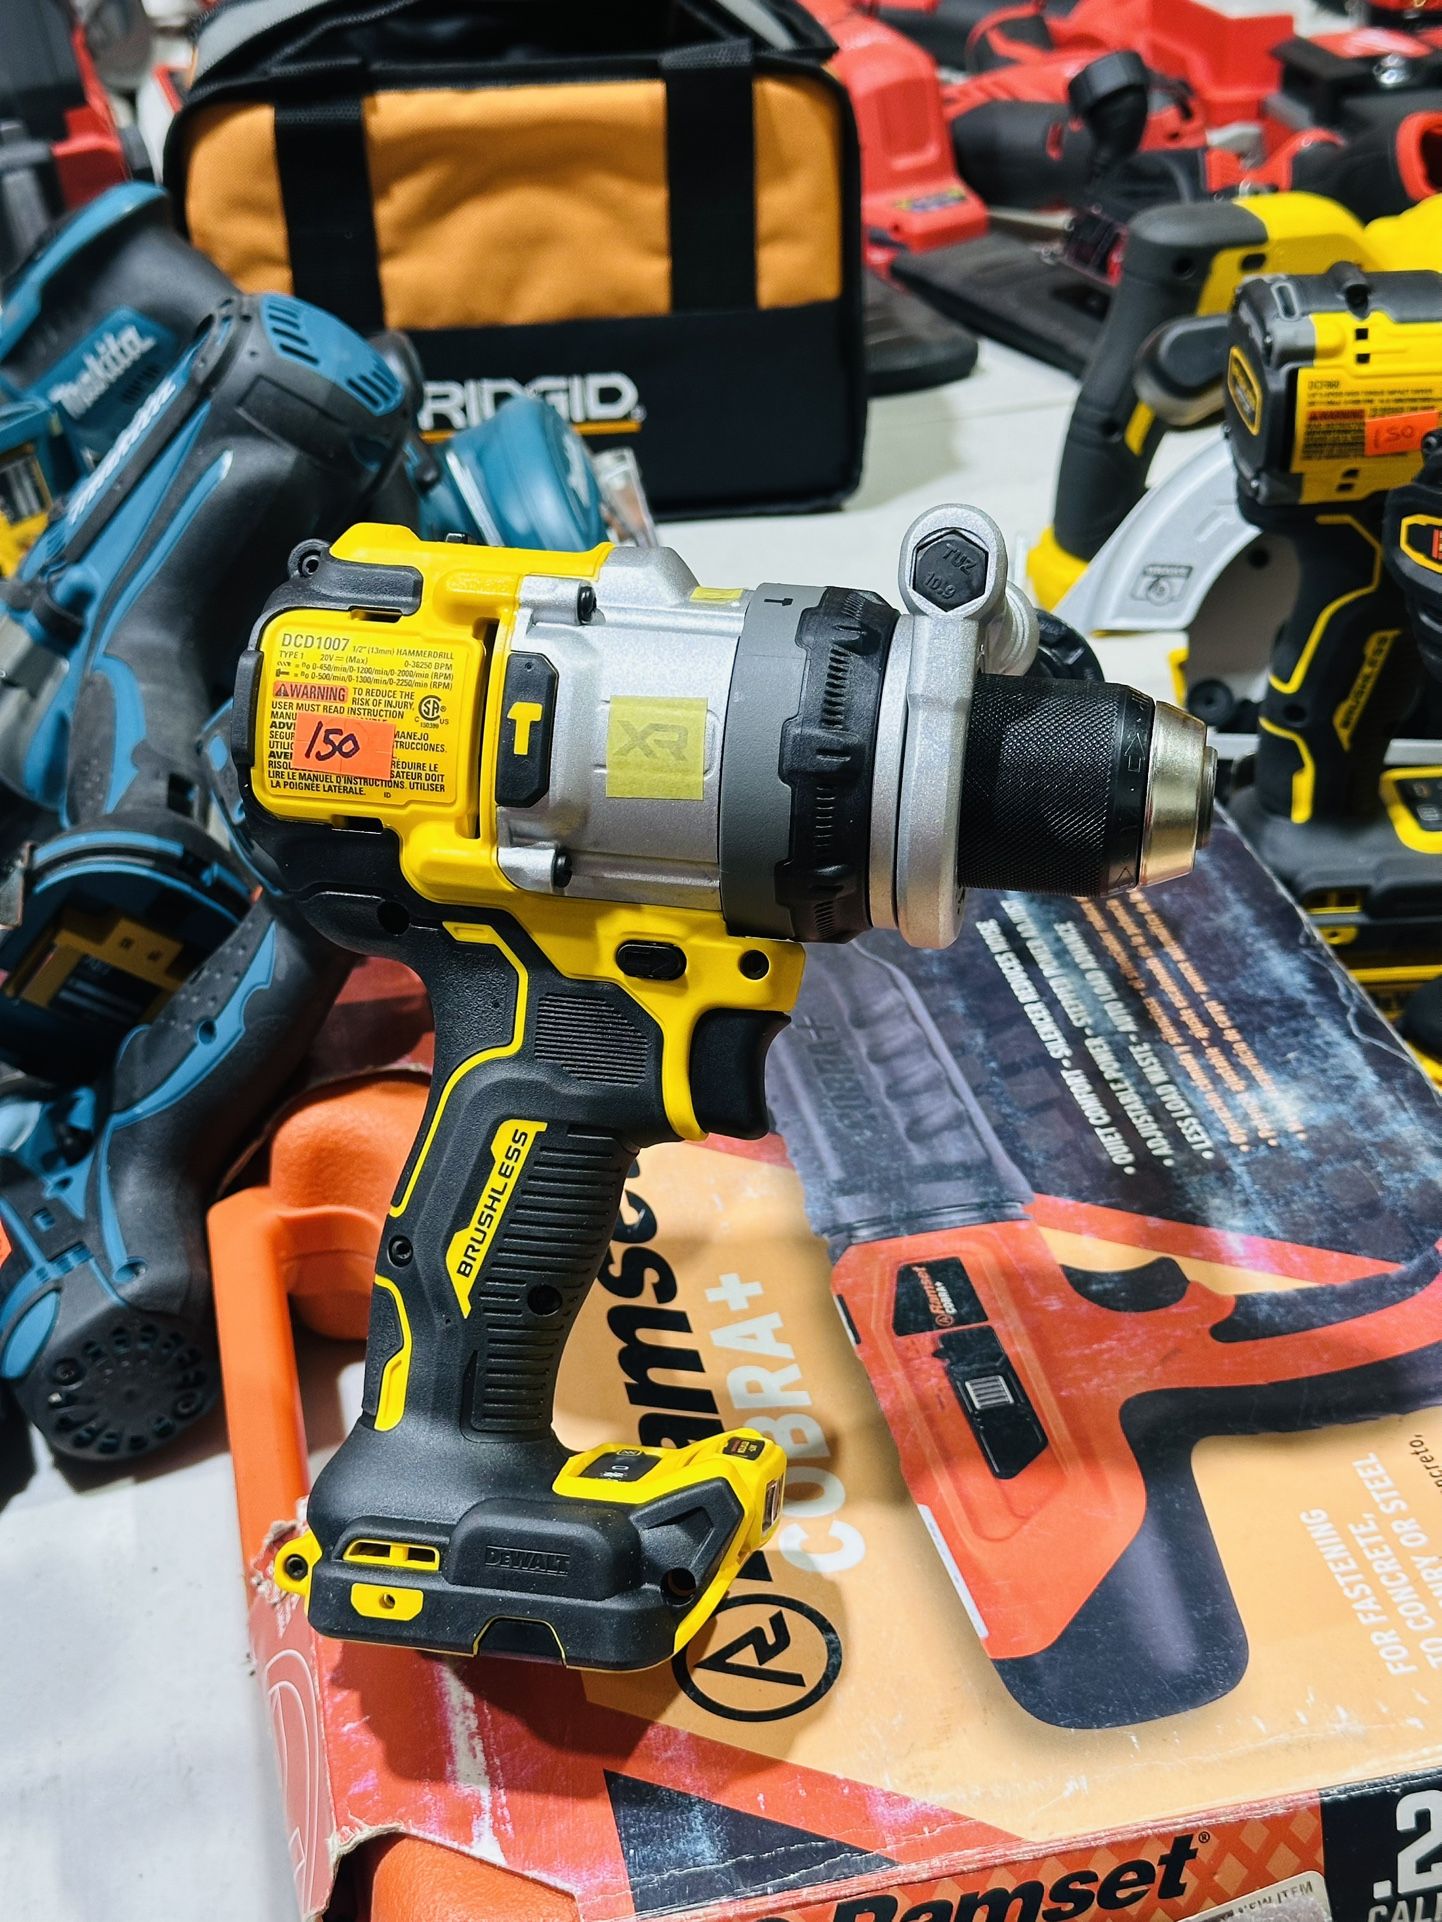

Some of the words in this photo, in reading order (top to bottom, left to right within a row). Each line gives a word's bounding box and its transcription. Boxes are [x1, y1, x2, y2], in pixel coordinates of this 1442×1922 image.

[943, 543, 977, 576] TUZ
[281, 633, 350, 651] DCD1007
[396, 648, 455, 660] HAMMERDRILL
[431, 671, 454, 680] (RPM)
[433, 663, 453, 671] BPM
[290, 684, 346, 701] WARNING
[352, 697, 370, 706] RISK
[371, 698, 383, 707] OF
[353, 687, 363, 696] TO
[365, 688, 398, 699] REDUCE
[399, 691, 415, 700] THE
[429, 681, 453, 690] (RPM)
[272, 701, 294, 711] USER
[296, 703, 321, 713] MUST
[323, 705, 345, 714] READ
[347, 706, 405, 719] INSTRUCTION
[305, 720, 360, 761] 150
[393, 740, 448, 753] TRUCCIONES.
[613, 719, 688, 761] XR
[268, 769, 285, 779] LIRE
[287, 772, 296, 780] LE
[298, 773, 334, 783] MANUEL
[409, 782, 445, 792] UTILISER
[424, 773, 445, 783] DOIT
[429, 763, 439, 772] LE
[270, 780, 281, 789] LA
[1021, 1001, 1074, 1058] SILENCER
[1082, 1035, 1126, 1079] POWER
[1128, 1042, 1170, 1083] WASTE
[1060, 1067, 1112, 1125] COMFORT
[1155, 1083, 1192, 1117] LOAD
[1110, 1079, 1173, 1156] ADJUSTABLE
[1176, 1117, 1213, 1150] LESS
[1094, 1124, 1136, 1165] QUIET
[457, 1129, 529, 1278] BRUSHLESS
[1352, 1452, 1410, 1515] STEEL
[1391, 1517, 1430, 1549] OR
[485, 1546, 570, 1577] DEWALT
[1299, 1507, 1390, 1627] FASTENING
[1348, 1512, 1437, 1633] CONCRETE,
[1370, 1628, 1419, 1677] FOR
